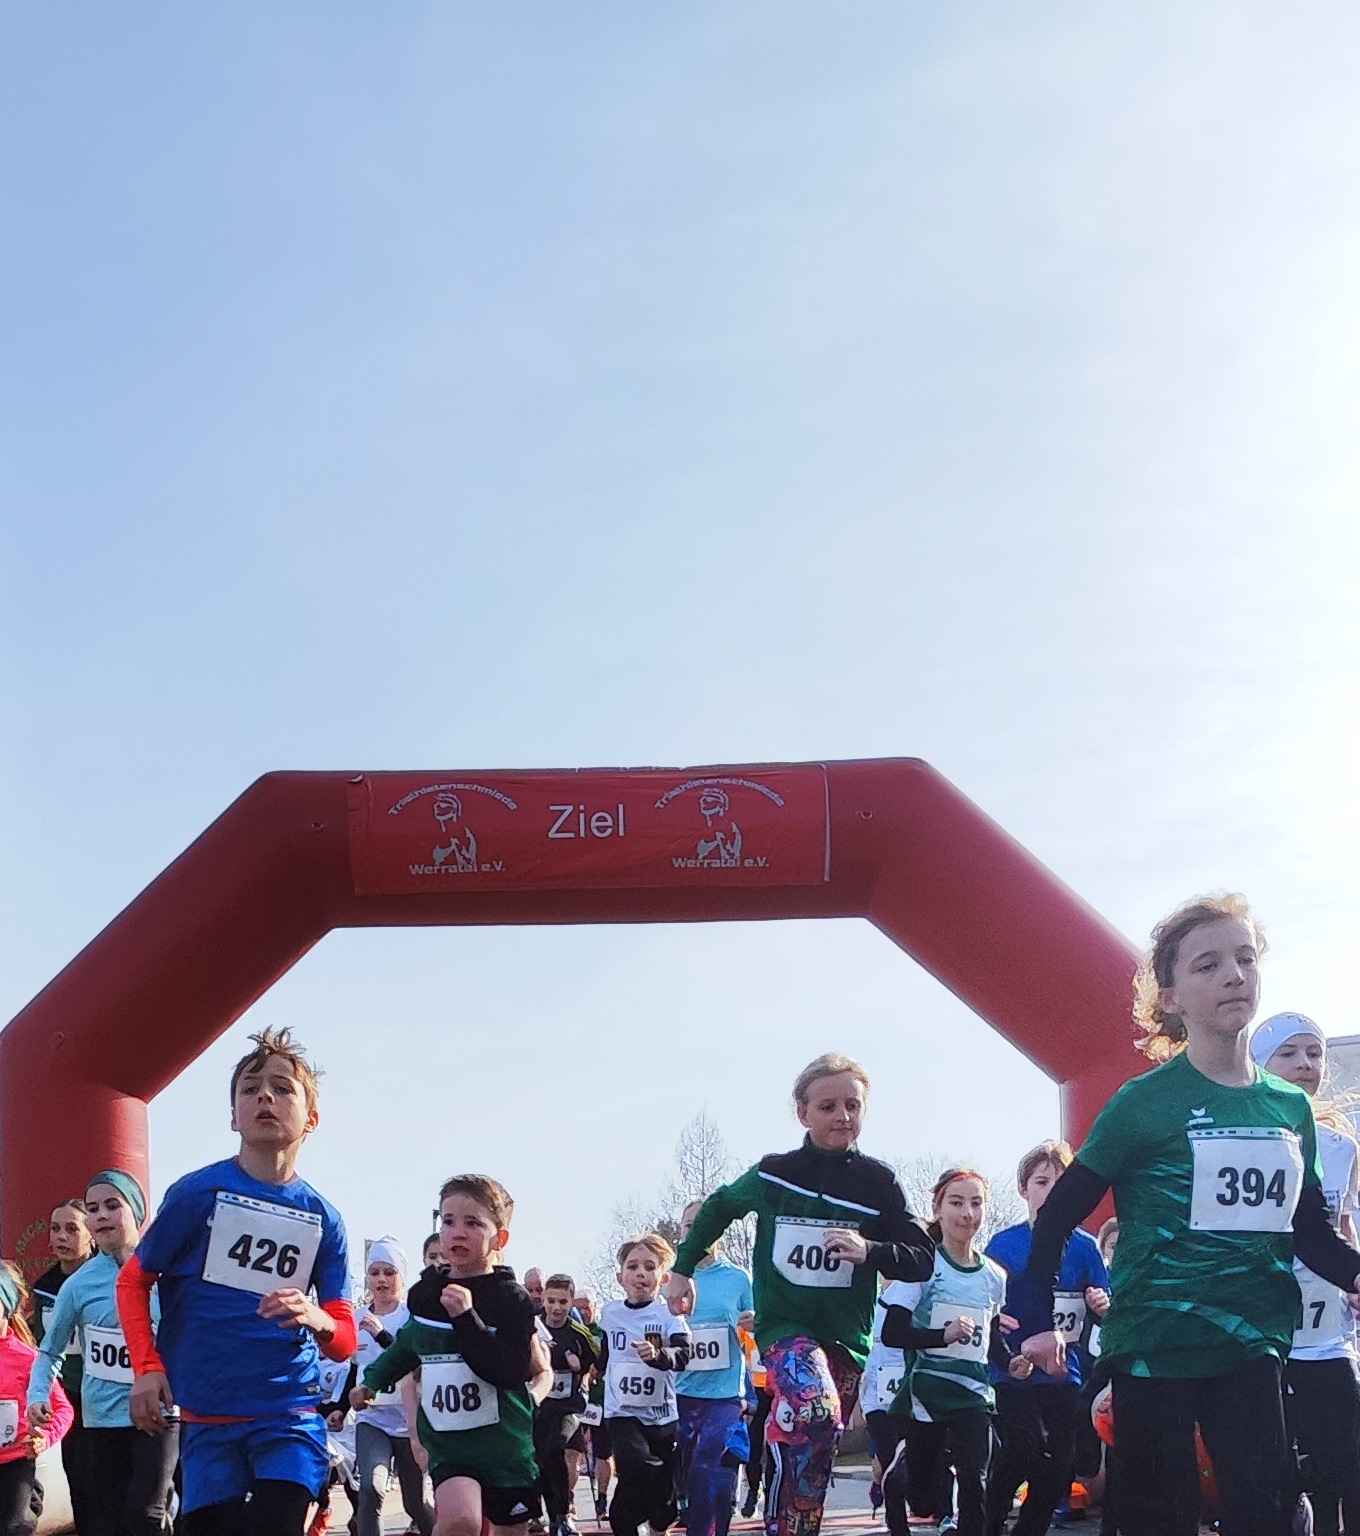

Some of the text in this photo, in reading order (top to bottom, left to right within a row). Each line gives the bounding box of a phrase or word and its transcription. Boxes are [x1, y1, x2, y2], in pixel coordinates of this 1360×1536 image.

[548, 803, 625, 838] Ziel
[409, 860, 506, 875] Werratal e.V.
[672, 856, 769, 868] Werratal e.V.
[1216, 1167, 1286, 1207] 394
[228, 1234, 300, 1278] 426
[611, 1331, 626, 1350] 10
[91, 1341, 131, 1368] 506
[432, 1382, 482, 1413] 408
[619, 1376, 655, 1395] 459
